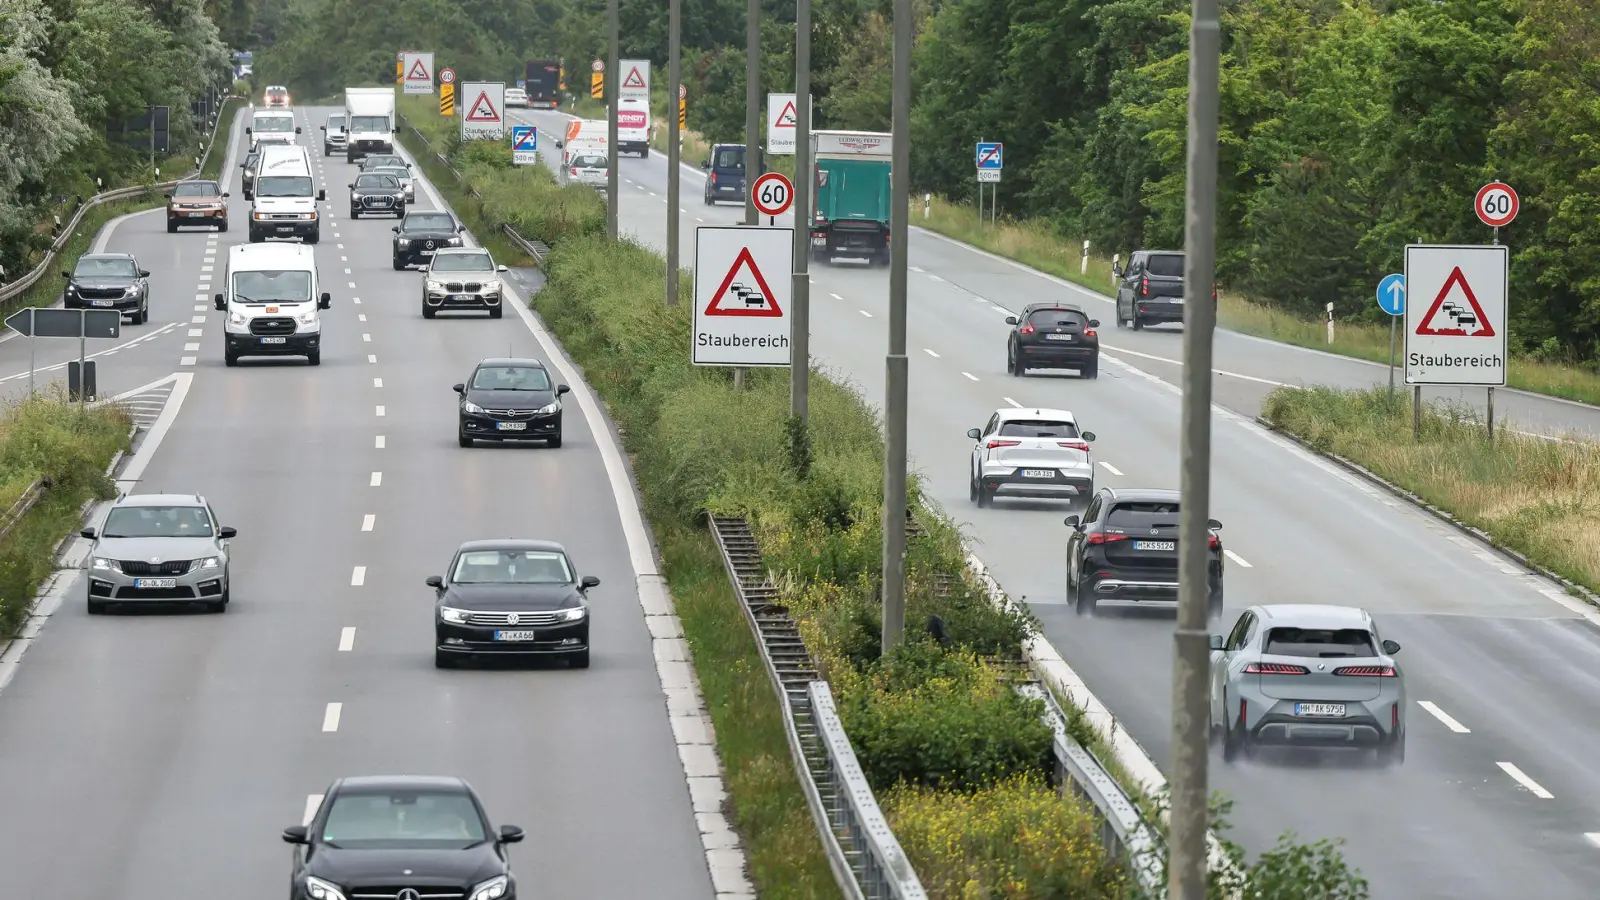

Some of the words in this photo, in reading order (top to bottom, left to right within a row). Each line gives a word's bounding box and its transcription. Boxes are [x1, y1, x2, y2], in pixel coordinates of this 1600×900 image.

[443, 73, 452, 81] 60
[464, 127, 502, 135] Staubereich
[761, 185, 785, 204] 60
[1485, 194, 1509, 214] 60
[698, 332, 789, 348] Staubereich
[1409, 353, 1501, 368] Staubereich
